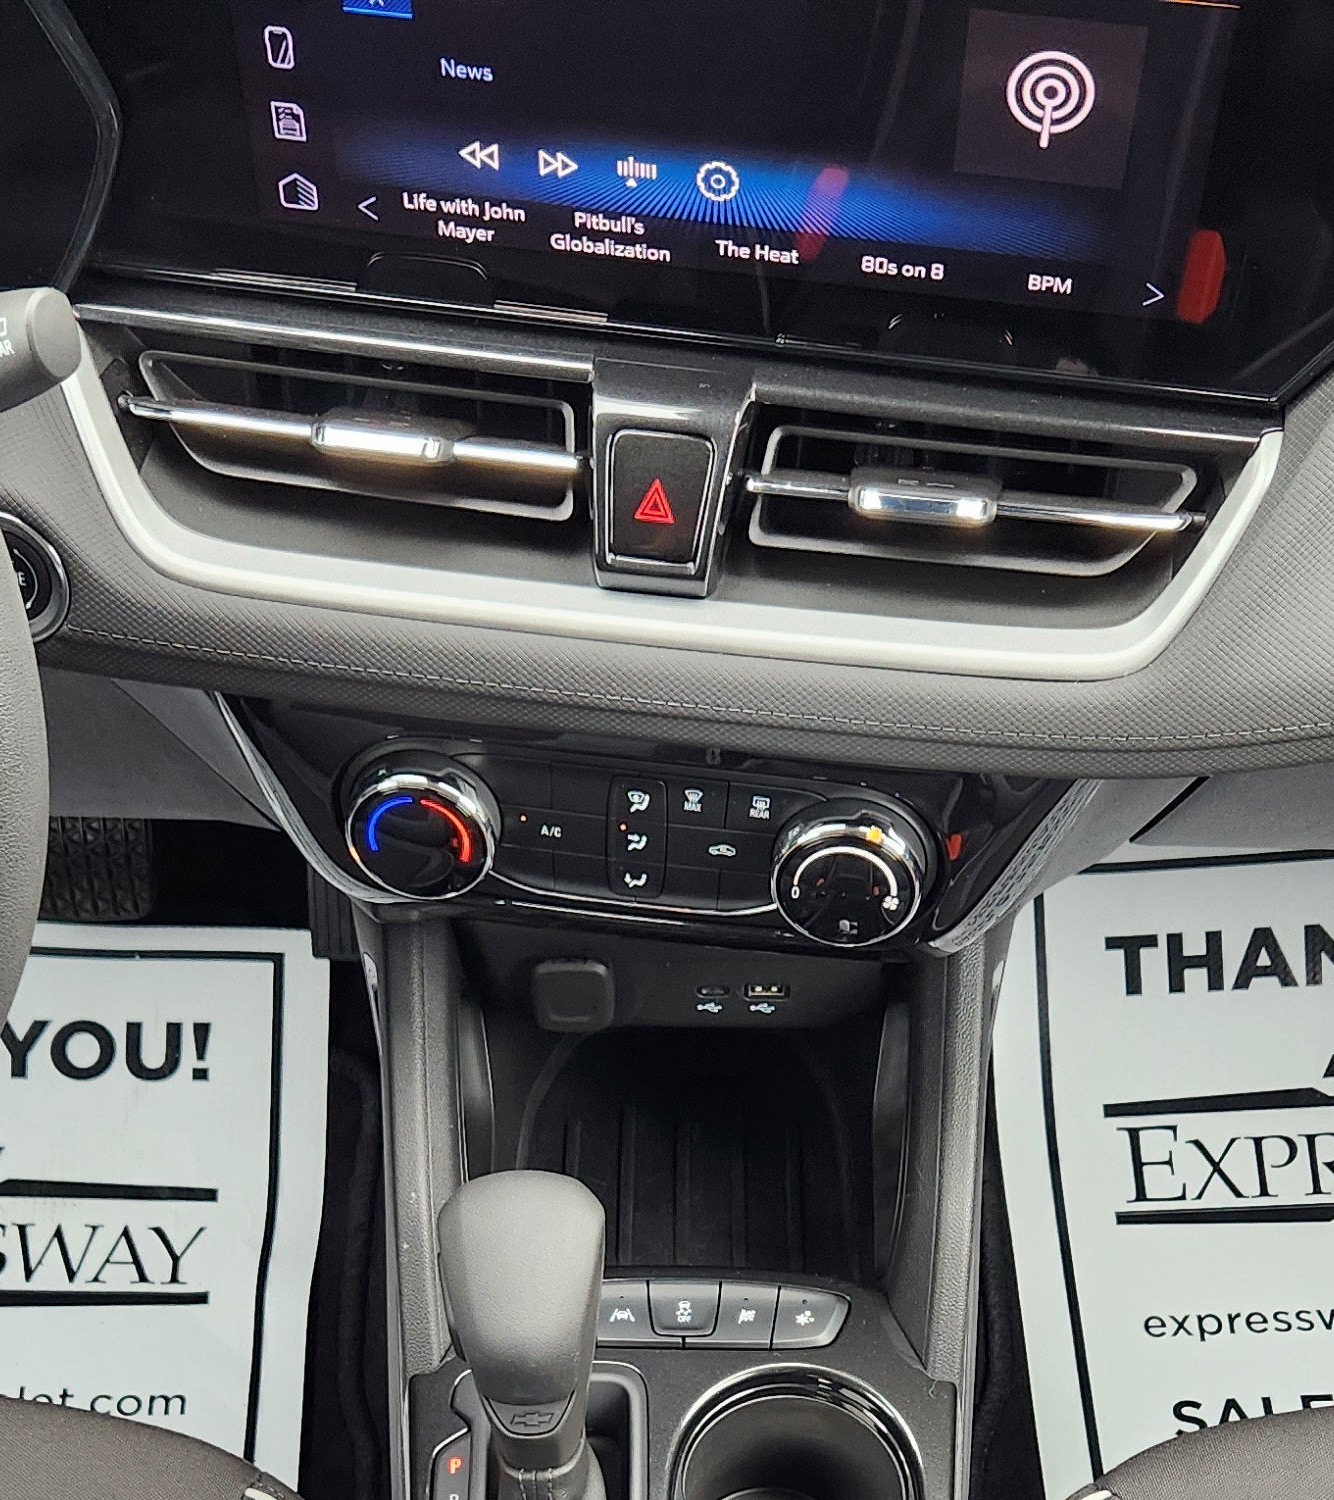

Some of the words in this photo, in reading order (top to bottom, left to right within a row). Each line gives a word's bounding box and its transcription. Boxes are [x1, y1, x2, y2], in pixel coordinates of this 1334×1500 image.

[439, 57, 494, 83] News
[402, 191, 437, 213] Life
[440, 197, 480, 218] with
[482, 200, 526, 223] John
[437, 219, 496, 244] Mayer
[573, 211, 645, 236] Pitbull's
[549, 232, 671, 263] Globalization
[715, 239, 750, 261] The
[753, 244, 800, 265] Heat
[861, 255, 898, 277] 80s
[901, 262, 926, 280] on
[930, 263, 945, 281] 8
[1027, 273, 1073, 295] BPM
[683, 801, 702, 813] MAX
[749, 807, 770, 820] REAR
[540, 824, 562, 838] A/C
[0, 1019, 212, 1083] YOU!
[449, 1457, 462, 1474] P
